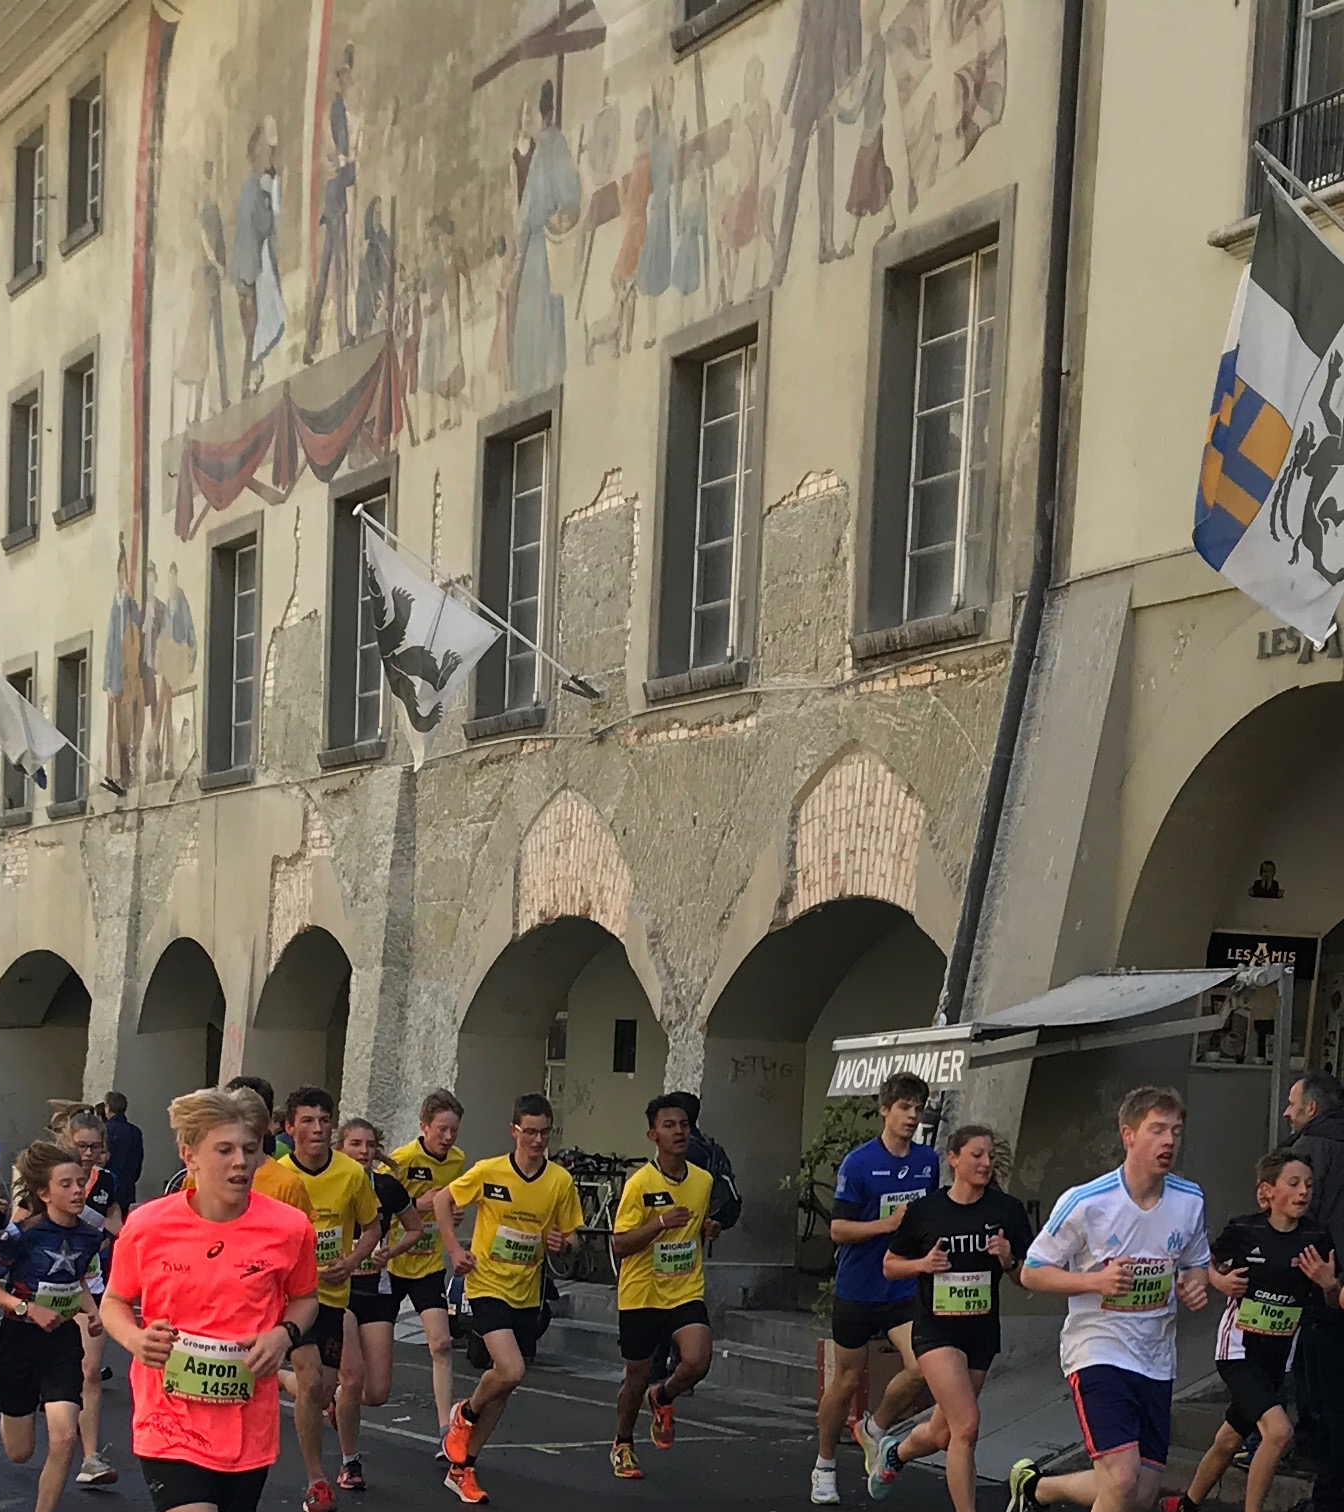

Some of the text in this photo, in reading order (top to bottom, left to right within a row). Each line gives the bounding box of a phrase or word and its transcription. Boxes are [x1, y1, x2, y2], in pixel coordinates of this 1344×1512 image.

[1257, 625, 1300, 659] LES
[1227, 948, 1251, 960] LES
[887, 1191, 920, 1203] MIGROS
[317, 1229, 336, 1239] ROS
[940, 1234, 990, 1253] CITIU
[949, 1286, 980, 1299] Petra
[1254, 1289, 1289, 1304] CRAFT
[964, 1300, 988, 1310] 8793
[182, 1337, 217, 1352] Groupe
[183, 1355, 238, 1378] Aaron
[200, 1380, 249, 1397] 14528
